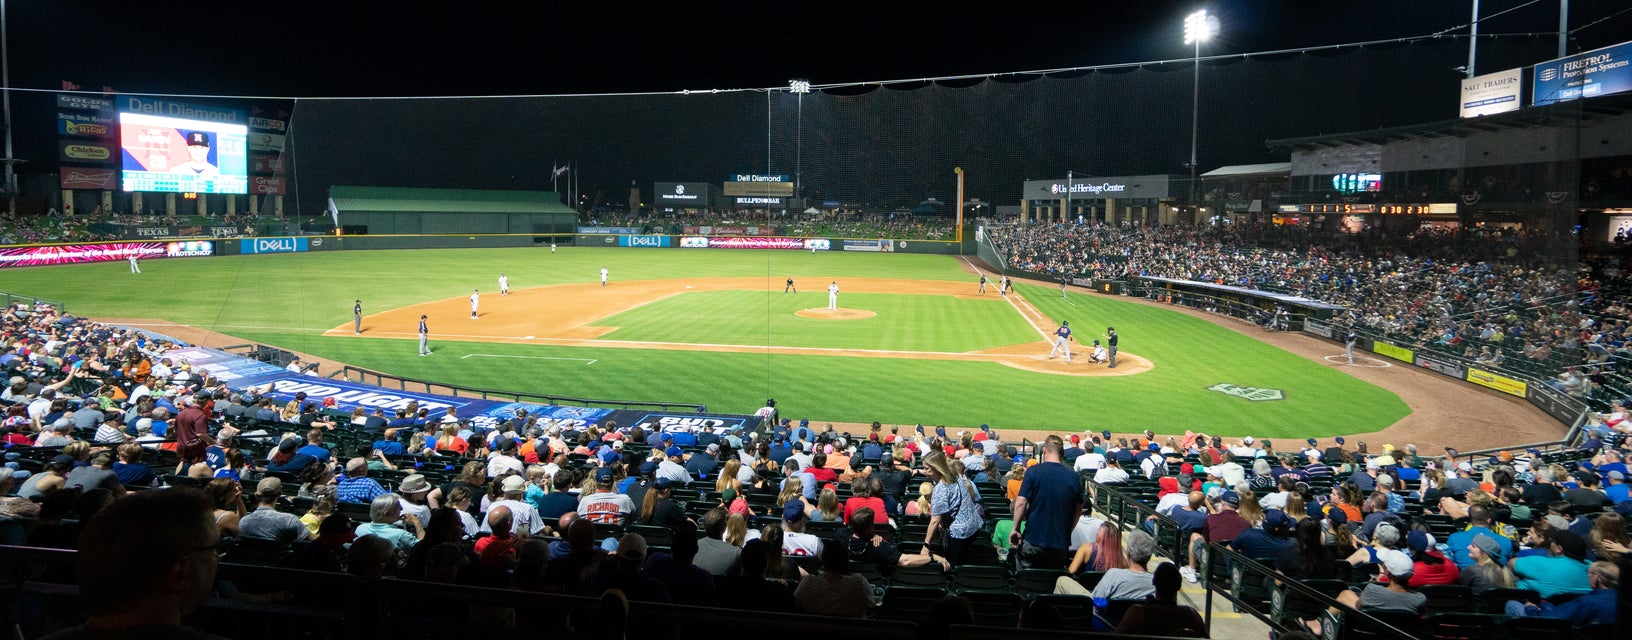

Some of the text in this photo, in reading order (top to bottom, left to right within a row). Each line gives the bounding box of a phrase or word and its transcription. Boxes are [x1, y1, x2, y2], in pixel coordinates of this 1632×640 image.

[1563, 53, 1612, 72] FIRETROL
[1563, 60, 1629, 79] Protecion Systems
[1464, 83, 1480, 91] SALT
[1484, 77, 1518, 89] TRADERS
[129, 98, 236, 121] Dell Diamond
[255, 176, 280, 186] Great
[737, 174, 782, 182] Dell Diamond
[257, 184, 278, 193] Clips
[1058, 182, 1126, 195] Uned Heritage Center
[137, 228, 169, 236] TEXAS
[260, 240, 293, 251] DELL
[632, 237, 658, 246] DELL
[324, 389, 453, 414] LIGHT
[659, 416, 725, 427] BUD
[587, 501, 620, 514] RICHARD
